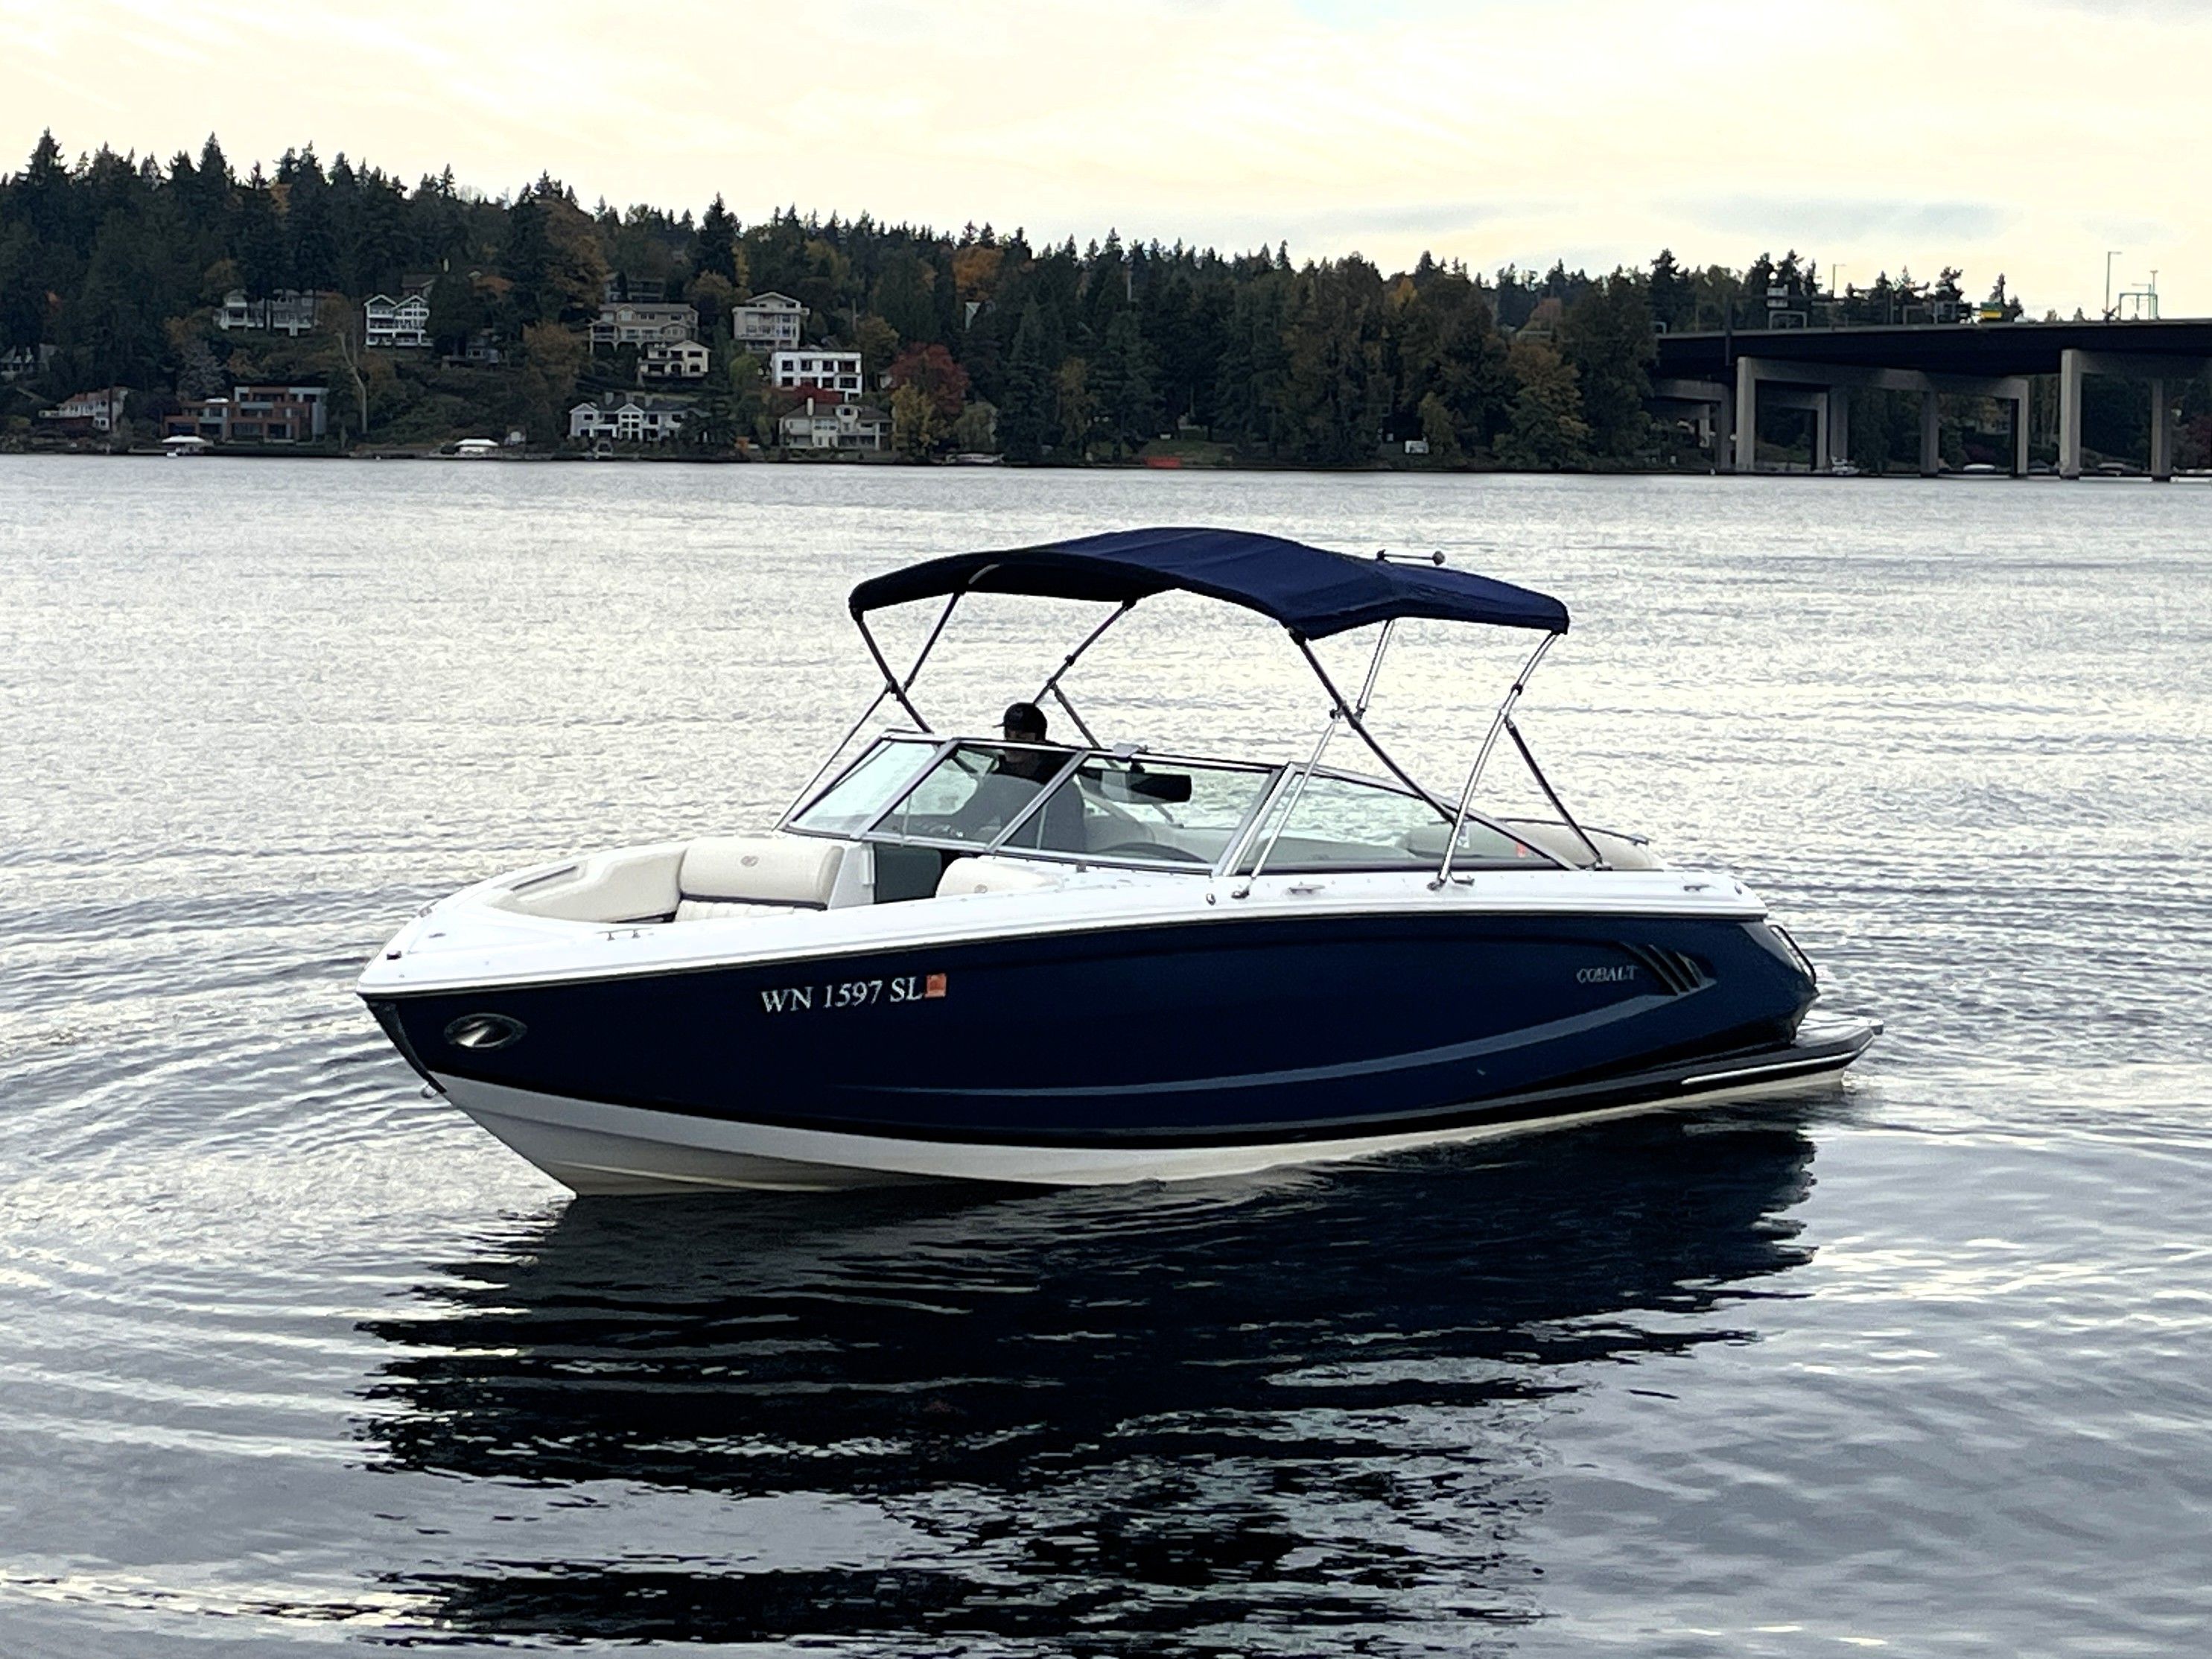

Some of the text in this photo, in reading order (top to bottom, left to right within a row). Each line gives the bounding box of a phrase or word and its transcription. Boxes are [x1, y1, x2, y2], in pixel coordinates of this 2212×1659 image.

[1577, 965, 1638, 983] COBALT
[761, 986, 814, 1012] WN
[823, 980, 883, 1008] 1597
[889, 976, 924, 1003] SL
